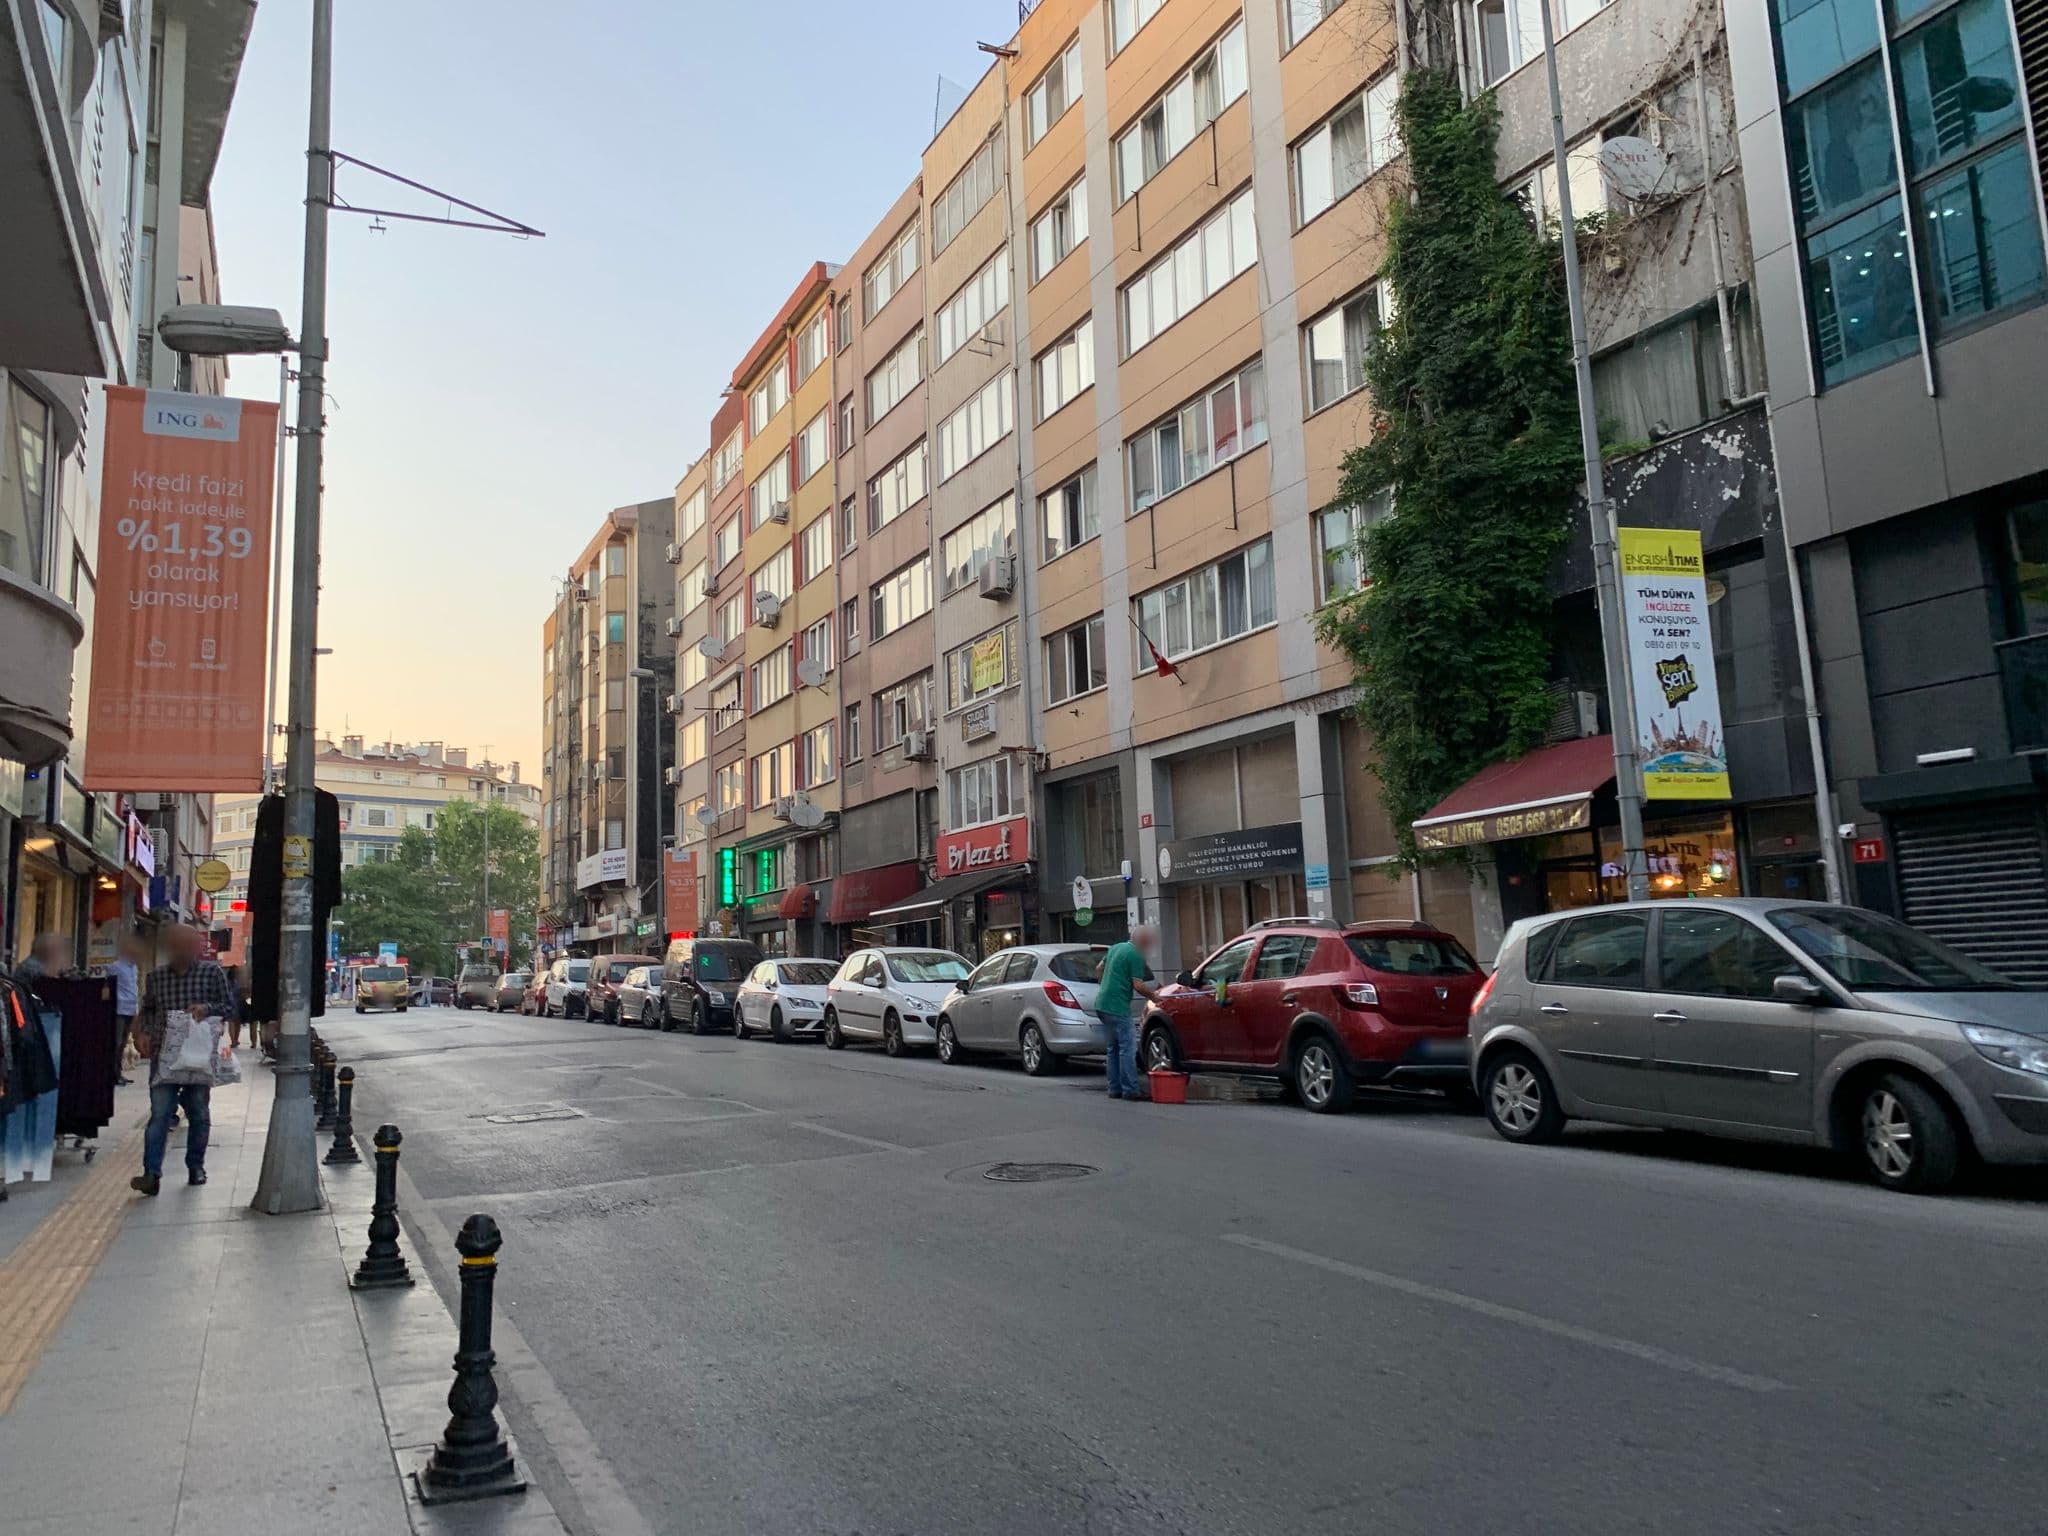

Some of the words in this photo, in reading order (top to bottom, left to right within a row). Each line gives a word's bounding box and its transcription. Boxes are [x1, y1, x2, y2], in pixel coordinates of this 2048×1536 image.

[157, 411, 197, 428] ING
[132, 470, 192, 494] Kredi
[199, 475, 244, 497] faizi
[128, 497, 174, 514] nakit
[179, 499, 246, 521] iadeyle
[117, 517, 254, 561] %1,39
[1625, 554, 1667, 566] ENGLISH
[1674, 555, 1699, 567] TIME
[148, 563, 220, 583] olarak
[129, 588, 239, 614] yansıyor!
[1637, 587, 1660, 598] TÜM
[1661, 588, 1696, 600] DÜNYA
[1652, 628, 1665, 637] YA
[1667, 628, 1691, 638] SEN?
[1662, 670, 1691, 690] sen
[948, 844, 965, 870] By
[1860, 844, 1877, 859] 71
